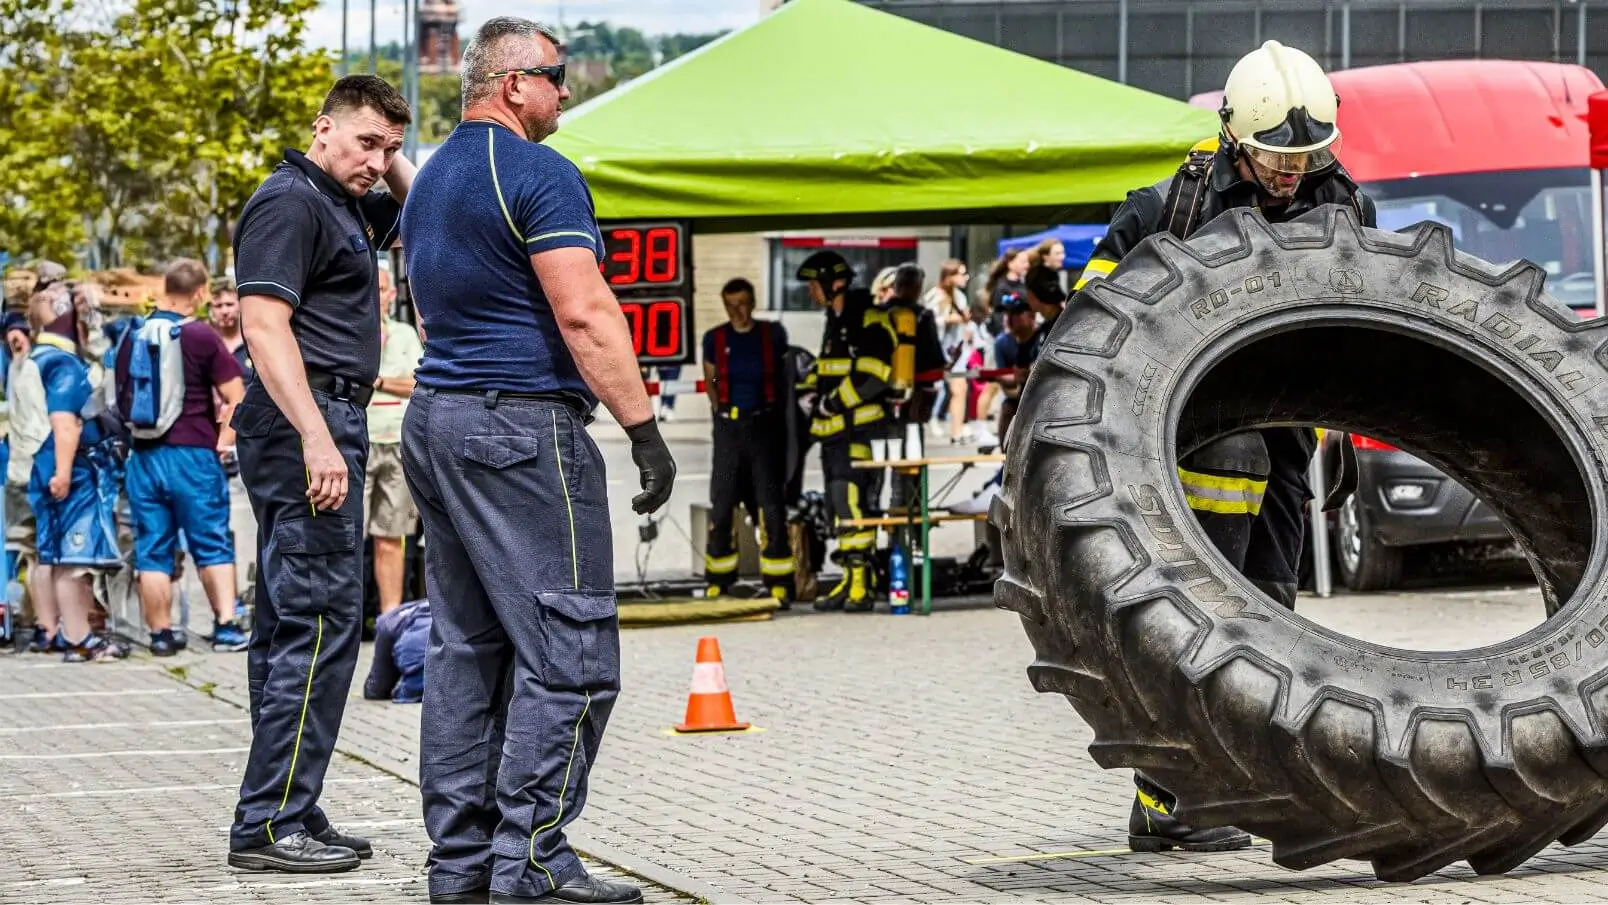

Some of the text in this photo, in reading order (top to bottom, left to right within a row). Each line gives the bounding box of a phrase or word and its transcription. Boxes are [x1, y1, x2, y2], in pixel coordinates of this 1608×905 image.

[1190, 271, 1282, 320] RD-01
[1411, 281, 1585, 391] RADIAL
[1446, 675, 1493, 691] 34
[1502, 669, 1522, 687] R
